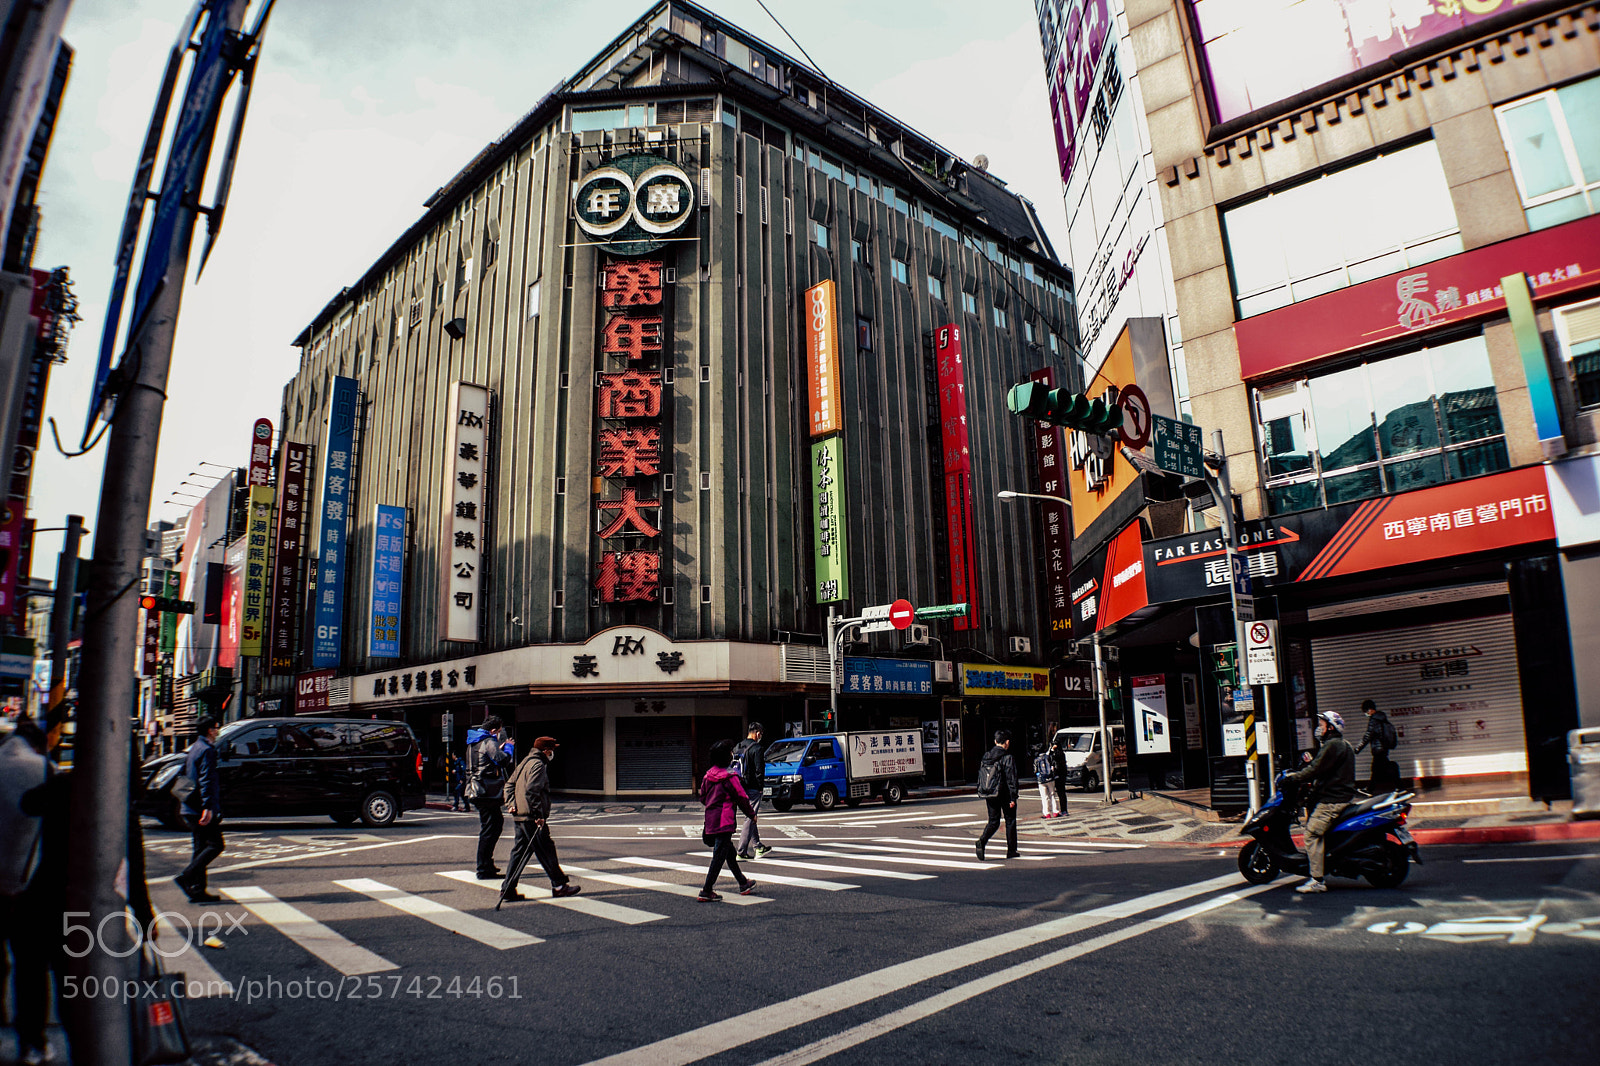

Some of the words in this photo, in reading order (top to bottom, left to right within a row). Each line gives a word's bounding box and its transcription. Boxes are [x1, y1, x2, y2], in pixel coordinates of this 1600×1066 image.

[595, 261, 663, 603] 萬年商業大樓
[250, 444, 269, 485] 萬年
[289, 450, 303, 473] U2
[1046, 481, 1057, 492] 9F
[284, 484, 299, 528] 電影館
[1383, 494, 1547, 540] 西寧南直營門市
[283, 540, 295, 550] 9F
[820, 580, 836, 590] 24H
[317, 625, 338, 639] 6F
[1052, 618, 1072, 631] 24H
[243, 625, 260, 641] 5F
[272, 657, 291, 667] 24H
[299, 678, 313, 695] U2
[920, 680, 931, 692] 6F
[1064, 676, 1081, 691] U2
